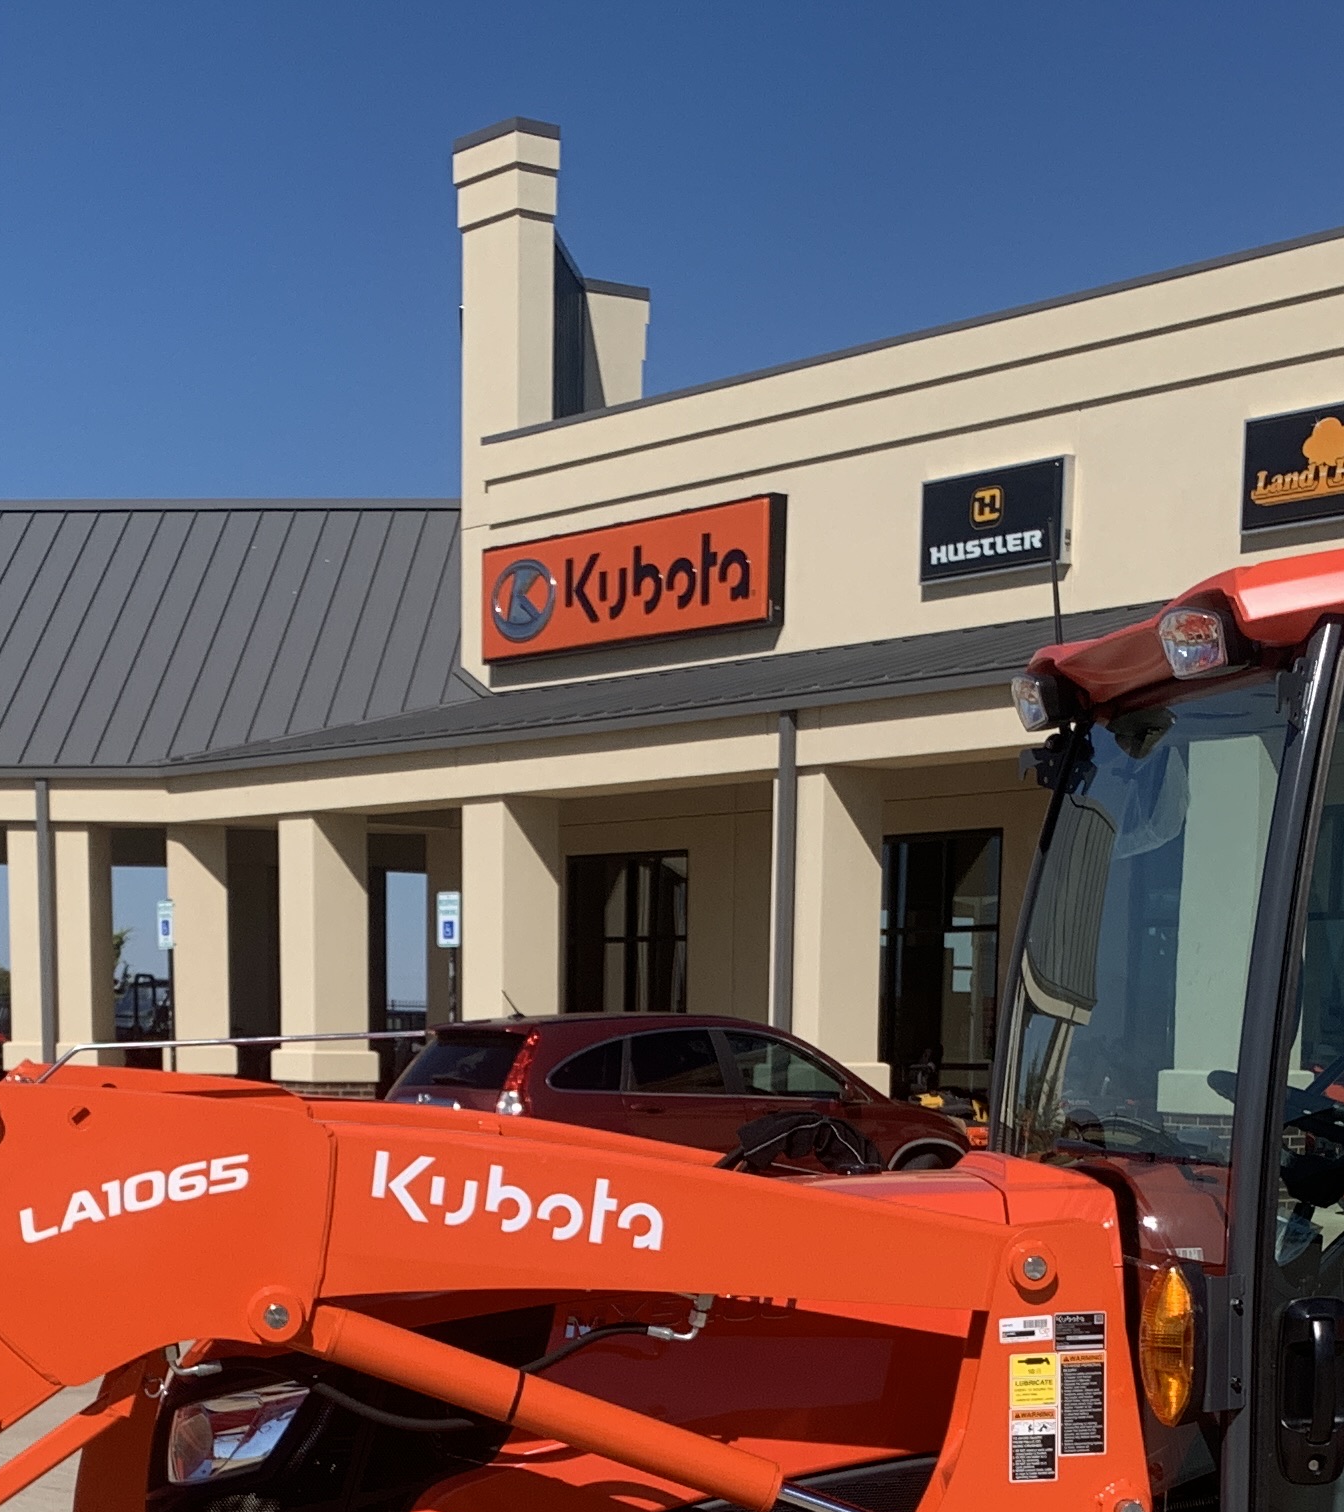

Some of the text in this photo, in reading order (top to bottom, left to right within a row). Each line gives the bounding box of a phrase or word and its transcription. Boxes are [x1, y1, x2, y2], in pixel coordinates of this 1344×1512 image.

[1253, 463, 1318, 497] Land
[564, 533, 751, 624] Kubota
[929, 529, 1043, 566] HUSTLER
[19, 1154, 250, 1244] LA1065
[371, 1150, 665, 1252] Kubota
